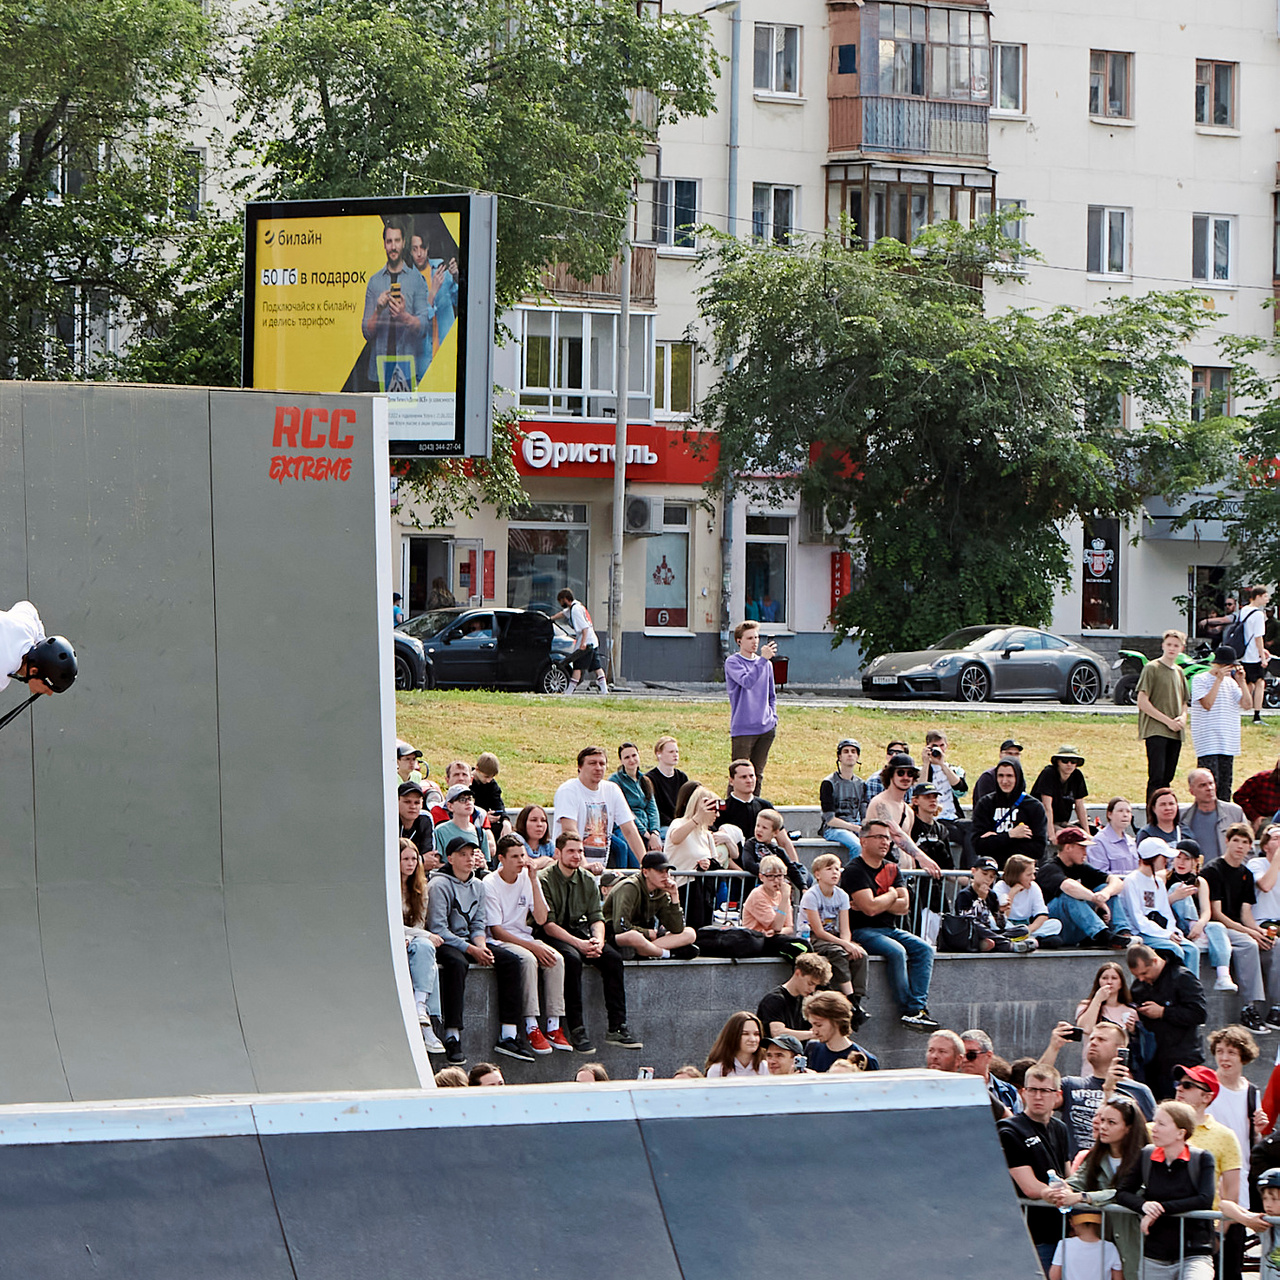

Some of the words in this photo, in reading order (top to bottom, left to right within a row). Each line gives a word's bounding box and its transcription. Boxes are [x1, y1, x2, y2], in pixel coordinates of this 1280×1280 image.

[278, 229, 322, 246] билайн
[263, 269, 278, 285] 50
[282, 268, 297, 285] Гб
[300, 272, 308, 284] в
[311, 271, 366, 288] подарок
[263, 300, 315, 313] Подключайся
[317, 303, 322, 311] к
[323, 300, 357, 313] билайну
[268, 318, 296, 327] делись
[298, 316, 335, 329] тарифом
[272, 406, 356, 449] RCC
[269, 455, 353, 485] EXTREME
